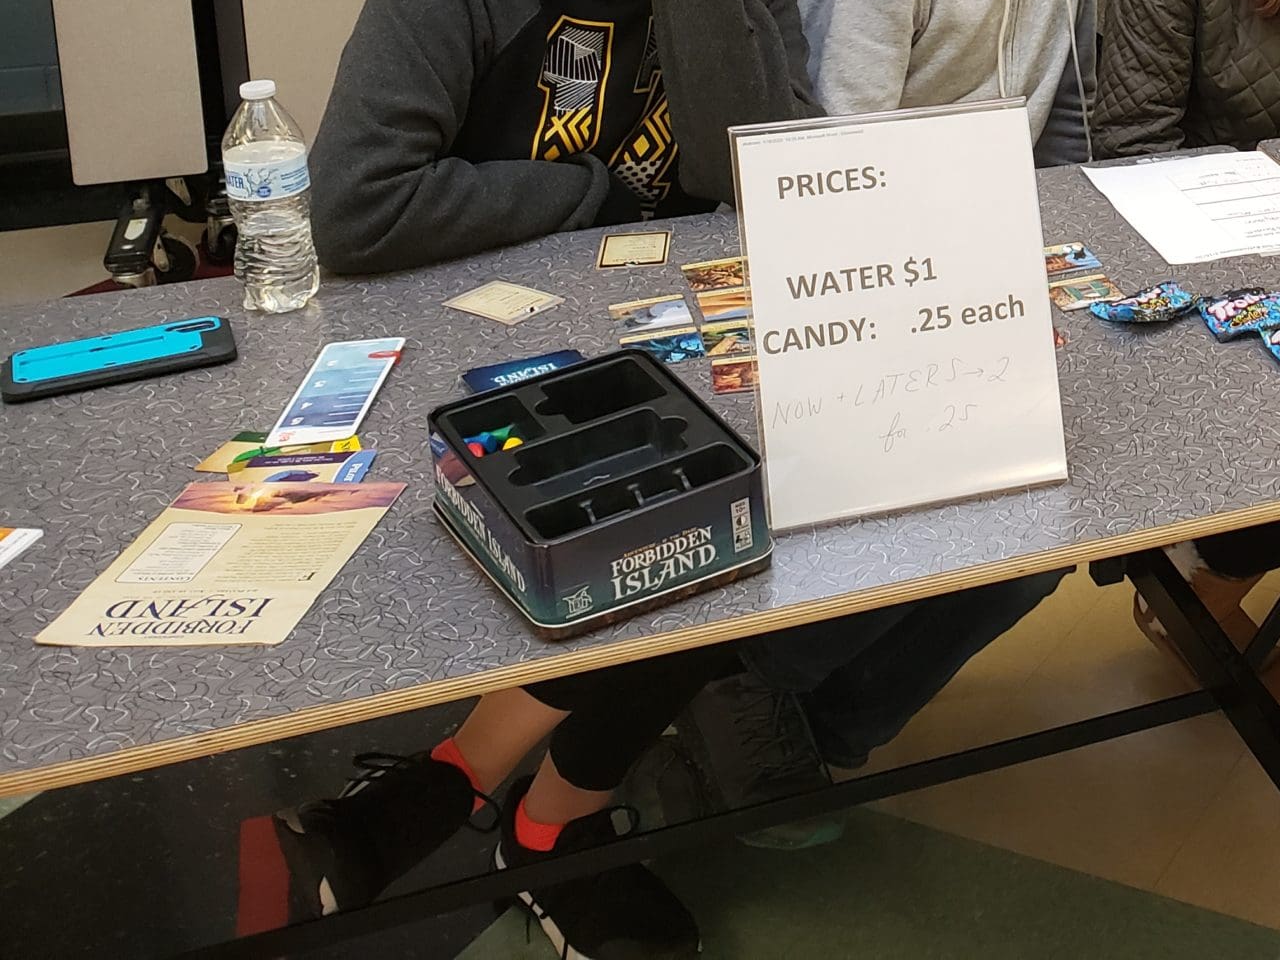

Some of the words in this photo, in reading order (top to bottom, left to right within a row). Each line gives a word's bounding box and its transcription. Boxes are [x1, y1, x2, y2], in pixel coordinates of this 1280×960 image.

[777, 165, 888, 200] PRICES:
[786, 262, 896, 300] WATER
[903, 256, 938, 287] $1
[762, 317, 878, 356] CANDY:
[909, 304, 952, 334] .25
[960, 294, 1026, 327] each
[772, 398, 824, 430] NOW
[853, 357, 960, 408] LATERS
[988, 356, 1011, 382] 2
[435, 463, 486, 541] FORBIDDEN
[487, 527, 526, 593] ISLAND
[610, 525, 713, 578] FORBIDDEN
[610, 543, 717, 600] ISLAND
[86, 618, 254, 637] FORBIDDEN
[105, 594, 274, 620] ISLAND
